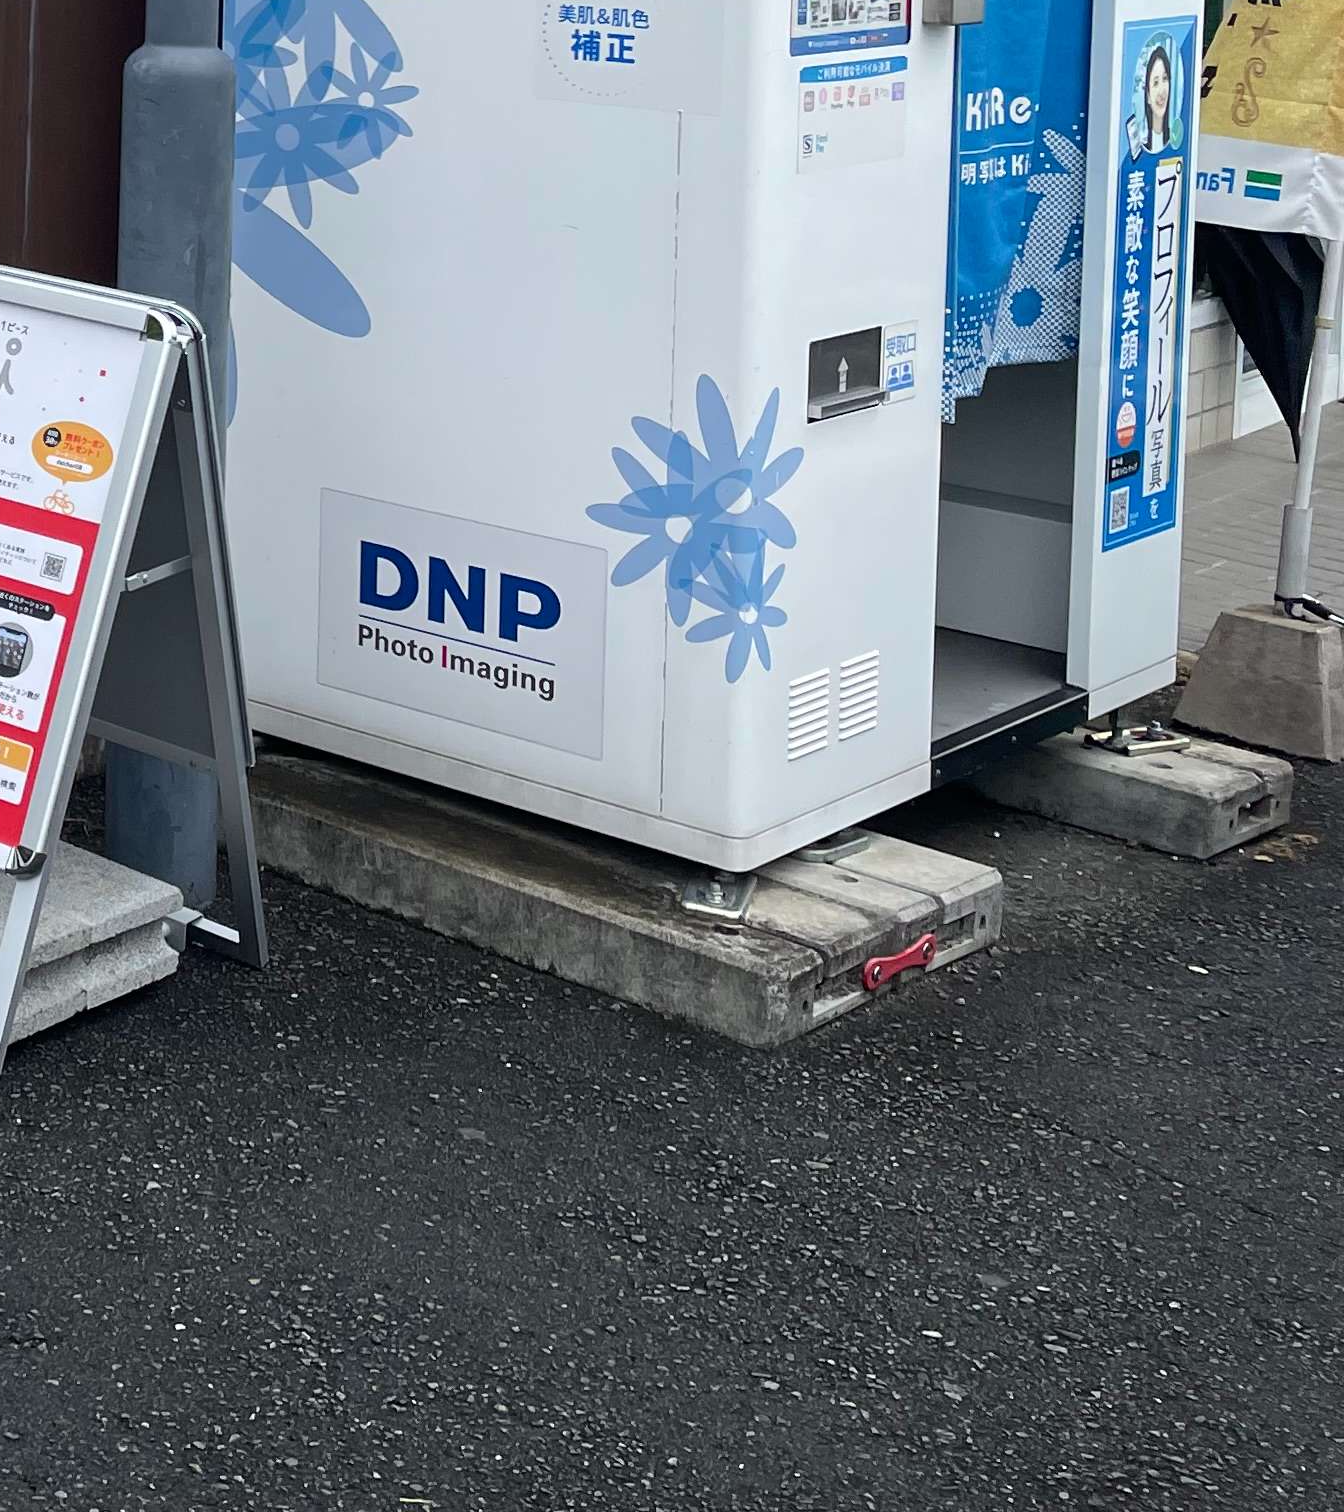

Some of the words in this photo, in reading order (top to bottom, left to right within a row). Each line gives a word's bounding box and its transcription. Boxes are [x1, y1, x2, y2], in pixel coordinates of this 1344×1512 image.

[558, 4, 650, 30] 美肌&肌色
[570, 30, 636, 65] 補正
[1119, 170, 1146, 399] 素敵な笑顔に
[886, 333, 917, 359] 受取口
[358, 539, 562, 643] DNP
[357, 623, 435, 665] Photo
[440, 644, 557, 702] Imaging
